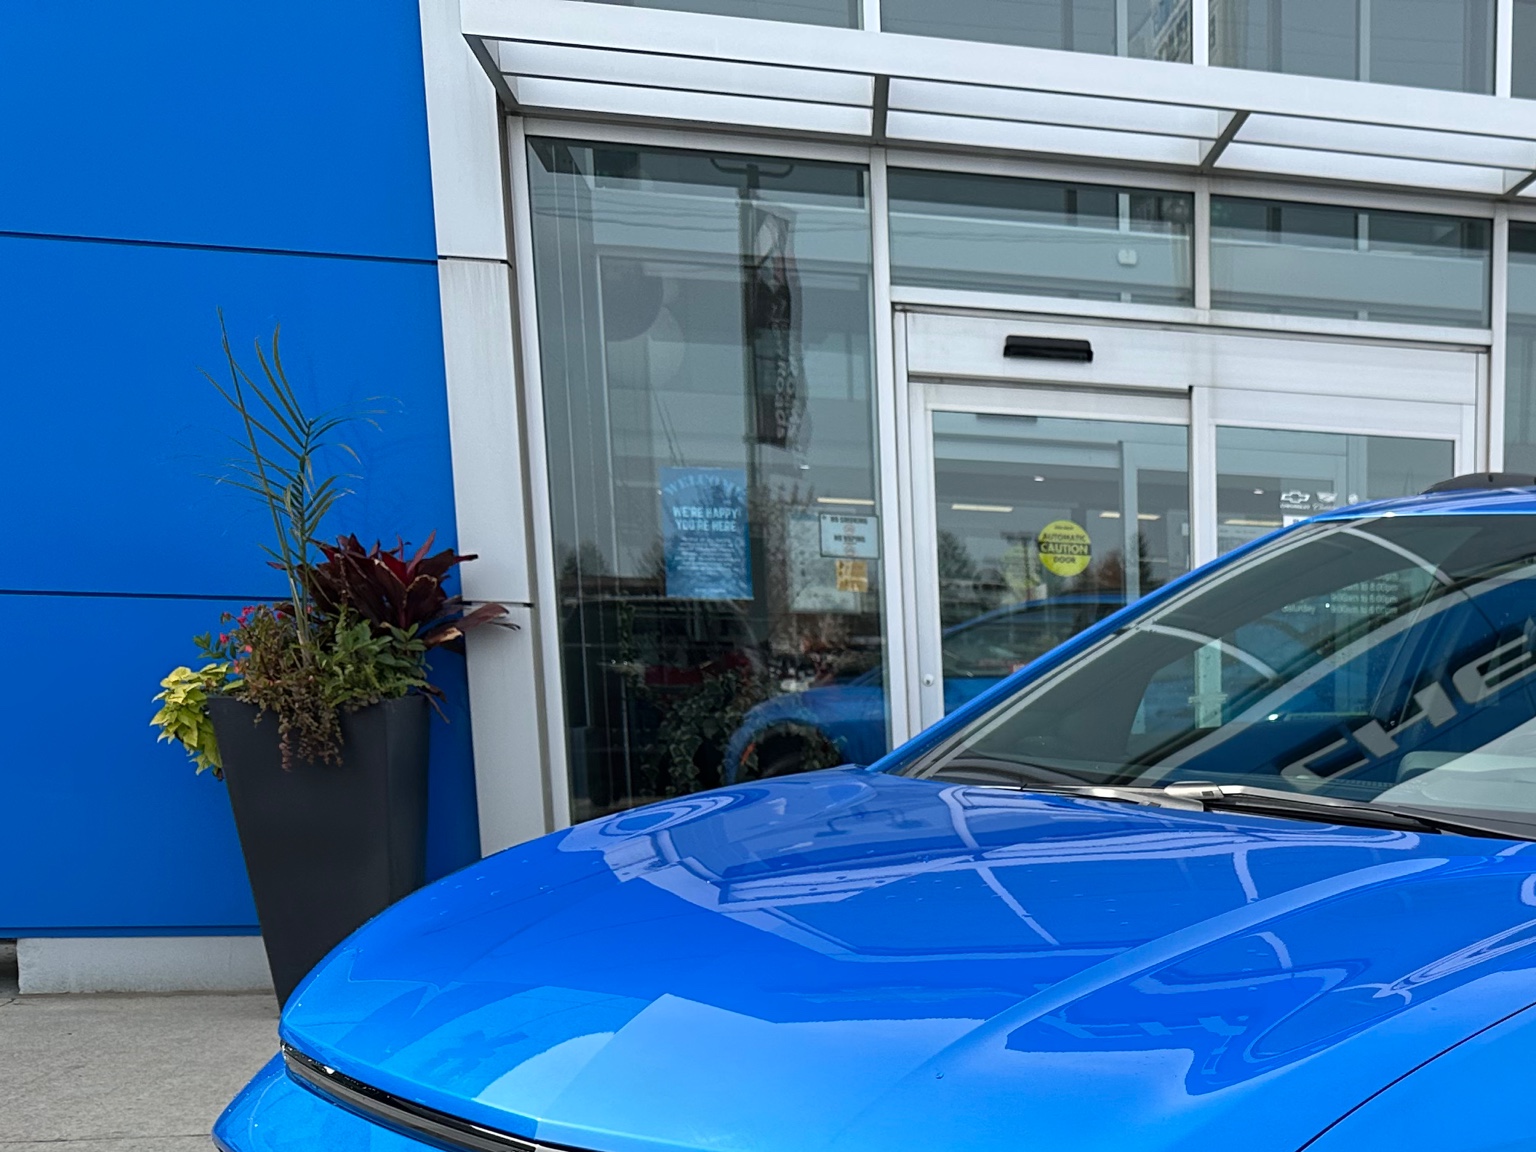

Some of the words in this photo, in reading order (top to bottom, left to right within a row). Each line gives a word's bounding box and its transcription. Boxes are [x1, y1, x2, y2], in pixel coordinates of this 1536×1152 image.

[664, 474, 746, 502] WELCOME
[706, 506, 738, 519] HAPPY
[711, 520, 737, 532] HERE
[1043, 533, 1087, 542] AUTOMATIC
[1040, 542, 1089, 554] CAUTION
